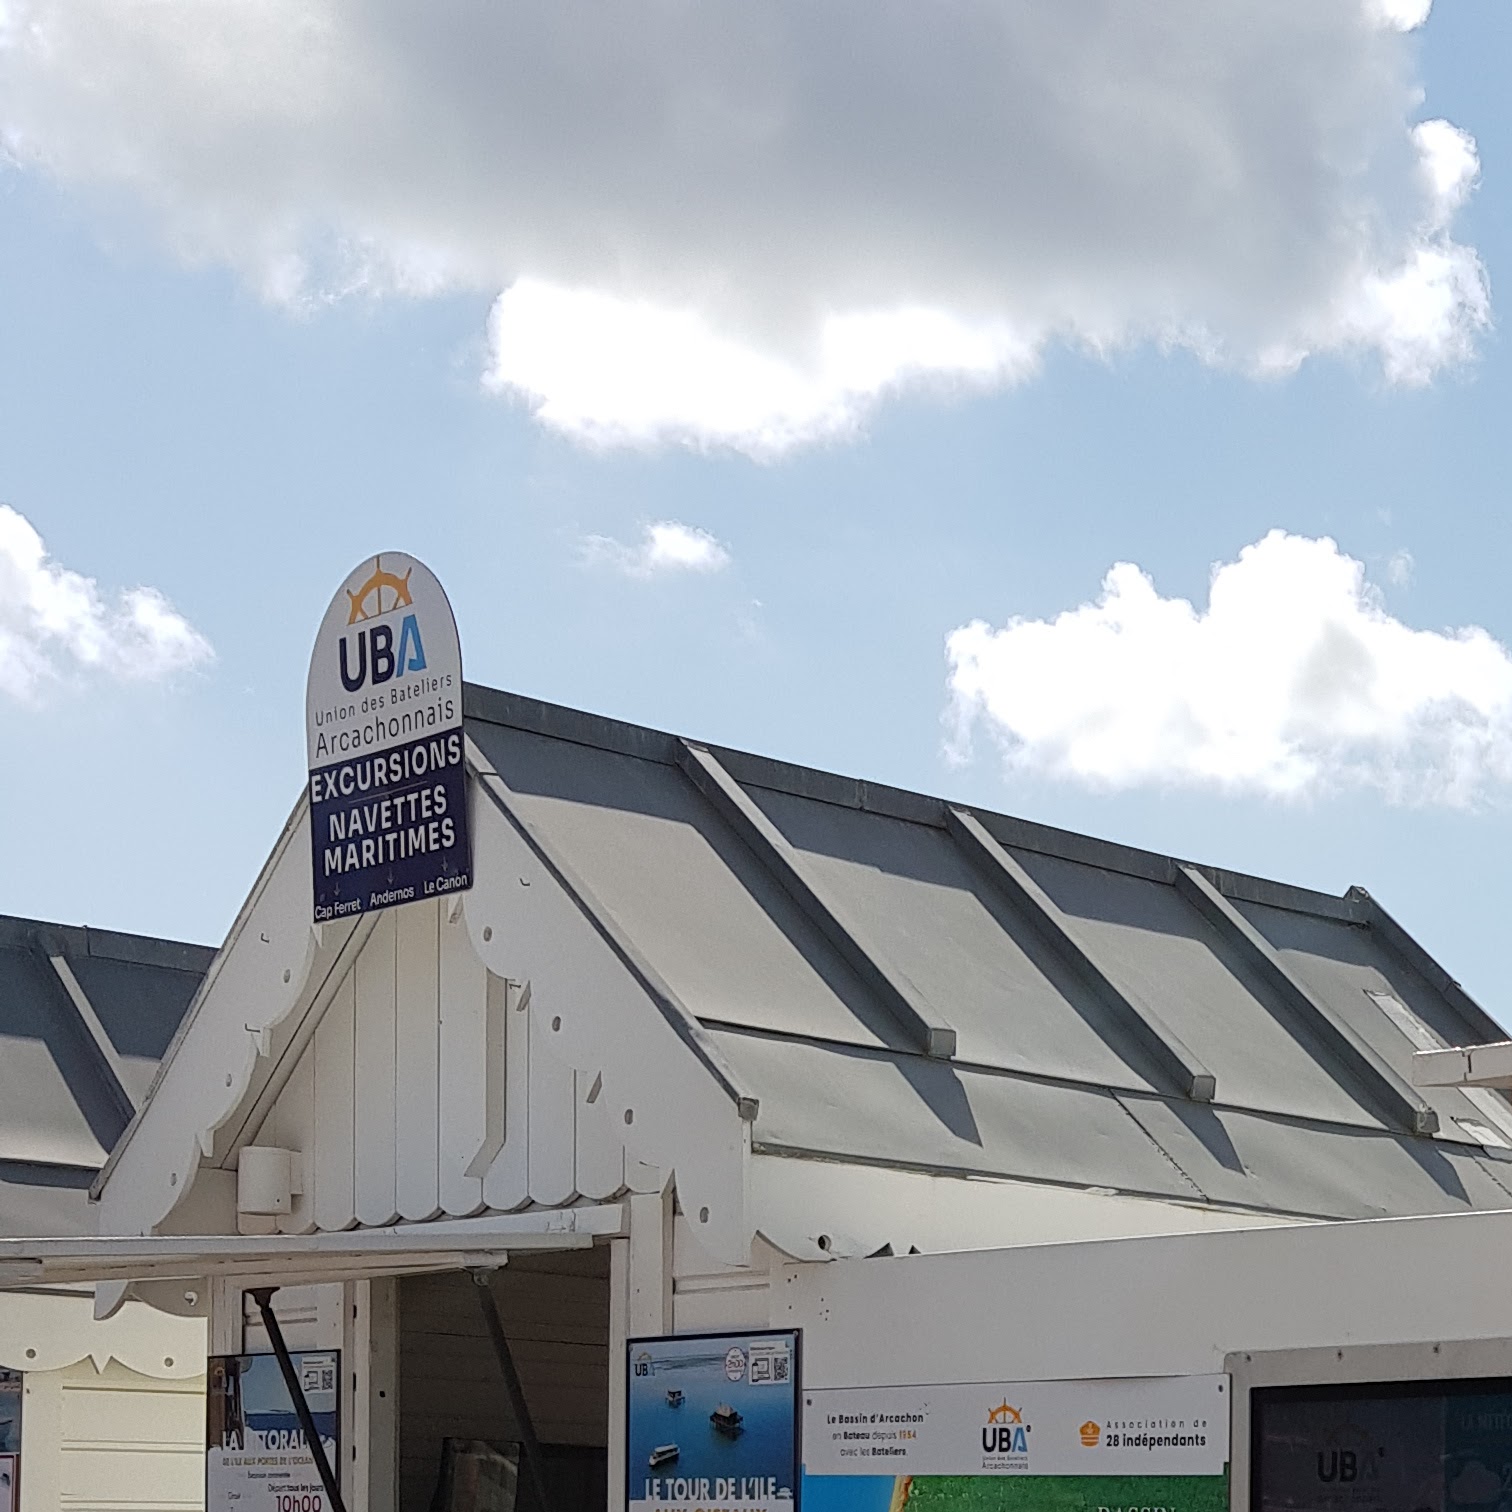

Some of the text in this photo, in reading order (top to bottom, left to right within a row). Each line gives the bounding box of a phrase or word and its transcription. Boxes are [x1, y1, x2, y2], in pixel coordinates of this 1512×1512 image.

[338, 613, 427, 692] UBA
[315, 674, 452, 727] Union des Bateliers
[315, 697, 454, 759] Arcachonnais
[311, 734, 461, 803] EXCURSIONS
[329, 784, 447, 842] NAVETTES
[324, 817, 455, 877] MARITIMES
[314, 873, 468, 920] Cap Ferret Andernos Le Canon
[827, 1412, 924, 1424] Le Bassin d'Arcachon
[981, 1425, 1029, 1453] UBA
[1105, 1419, 1208, 1429] Association de
[1105, 1433, 1206, 1452] 28 indépendants
[645, 1476, 777, 1501] LE TOUR DE L'ILE
